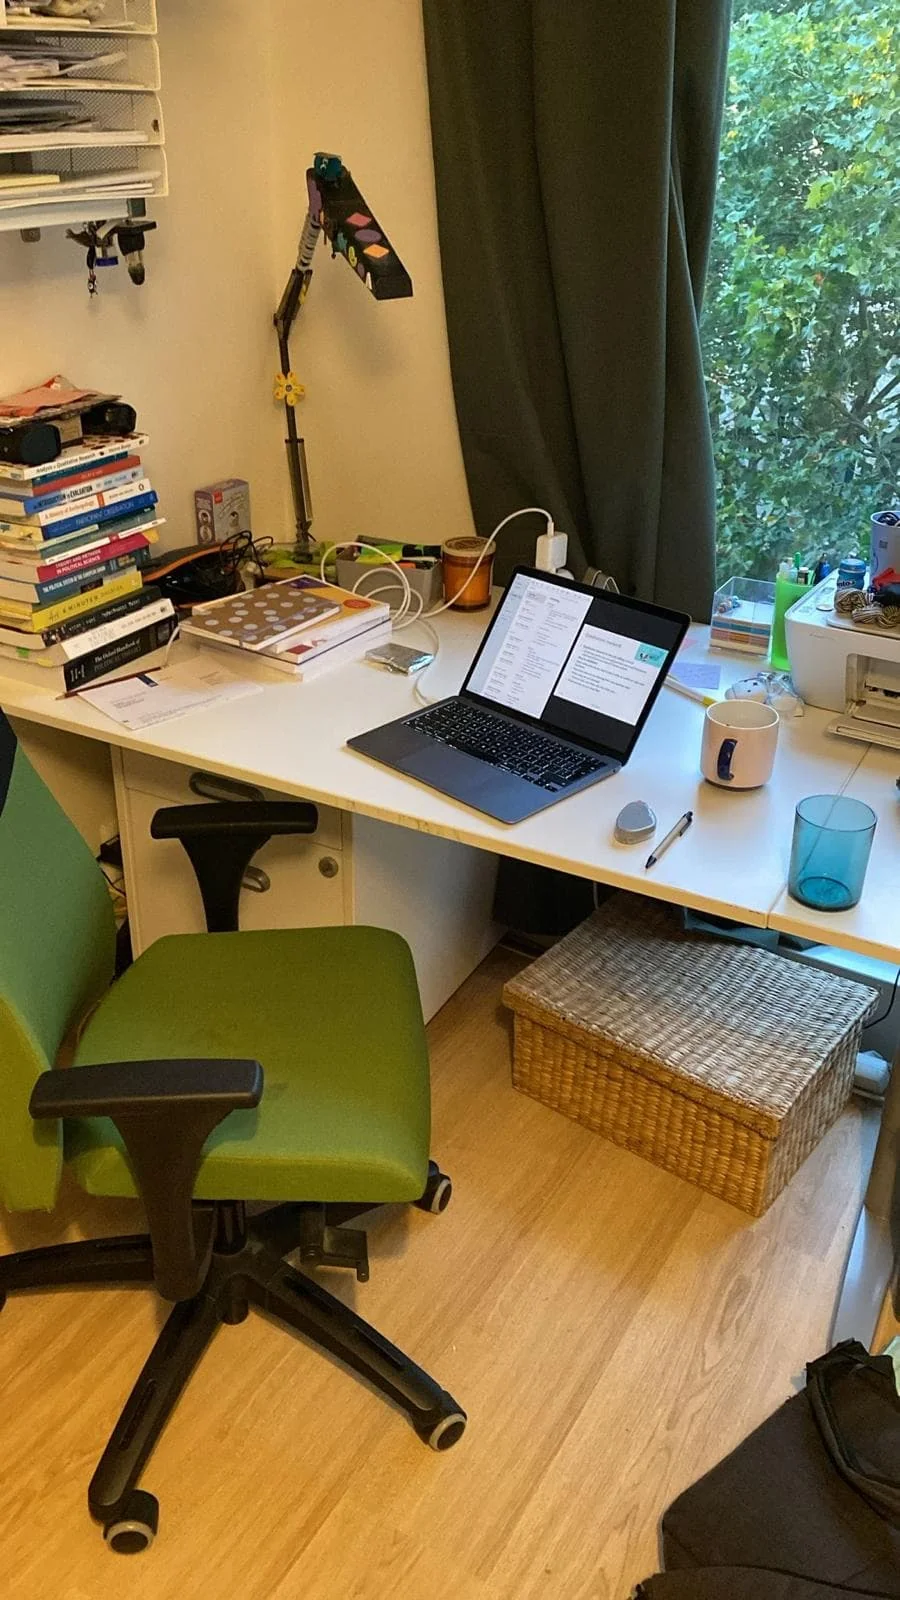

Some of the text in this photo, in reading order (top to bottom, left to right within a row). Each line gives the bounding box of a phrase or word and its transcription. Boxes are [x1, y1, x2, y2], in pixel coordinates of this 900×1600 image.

[70, 485, 93, 498] EVALUATION
[61, 560, 83, 572] POLITICAL
[82, 554, 101, 565] SCIENCE
[116, 642, 135, 652] Handbook
